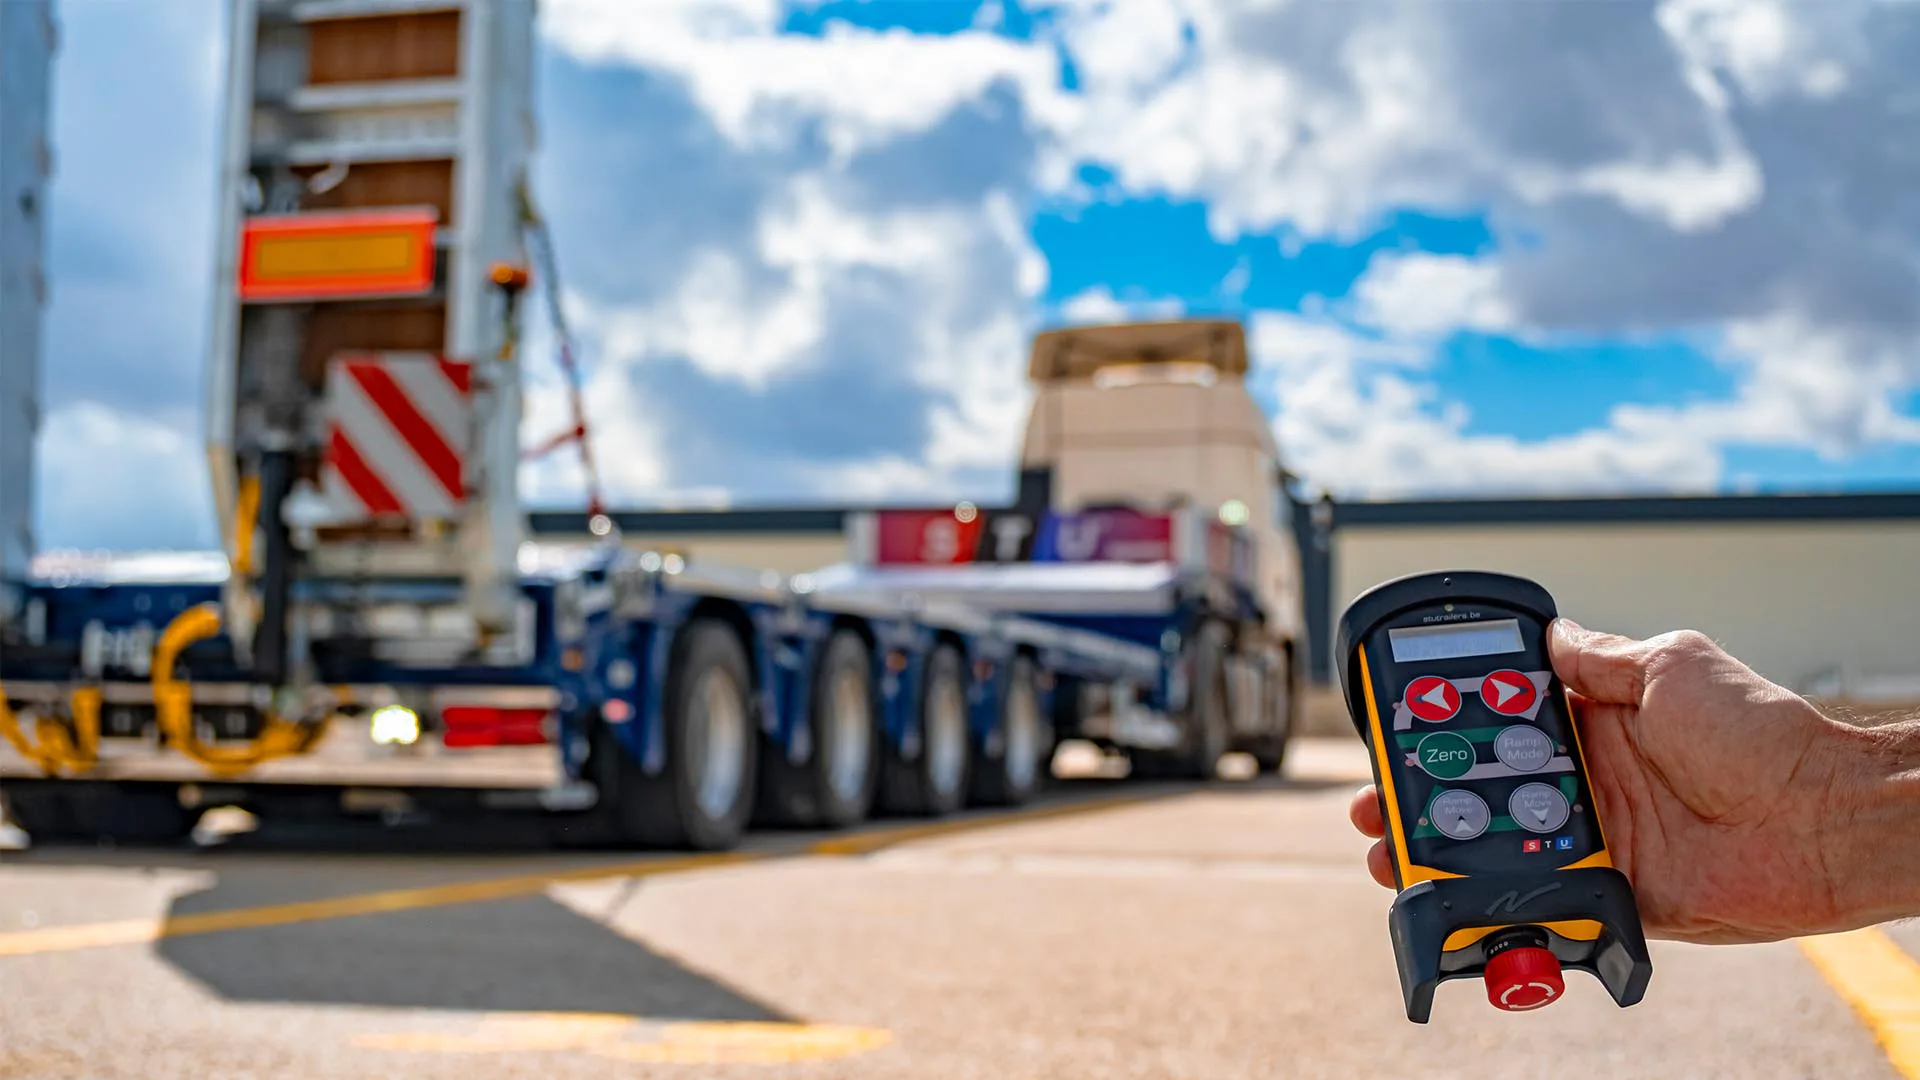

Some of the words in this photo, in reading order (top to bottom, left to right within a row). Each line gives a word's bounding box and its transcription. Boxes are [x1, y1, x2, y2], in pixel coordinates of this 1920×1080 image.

[1504, 737, 1544, 748] Ramp
[1426, 748, 1468, 763] Zero
[1507, 749, 1545, 761] Mode
